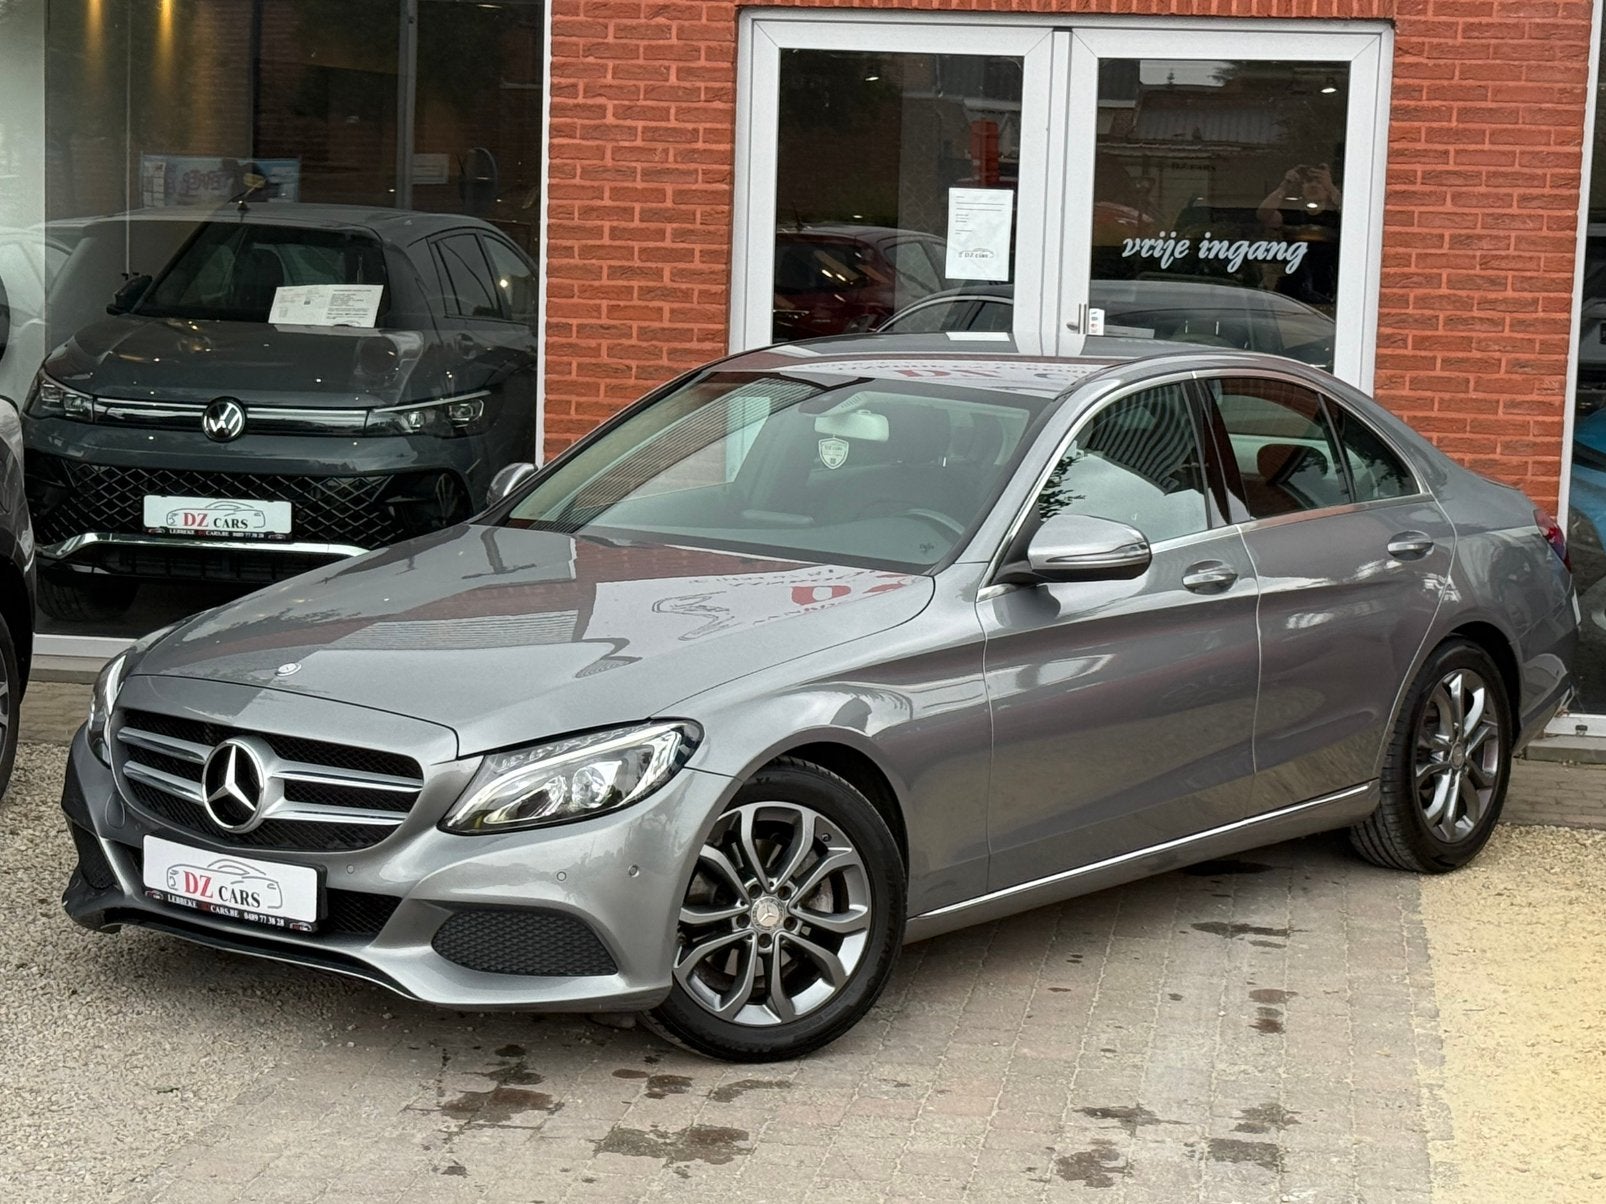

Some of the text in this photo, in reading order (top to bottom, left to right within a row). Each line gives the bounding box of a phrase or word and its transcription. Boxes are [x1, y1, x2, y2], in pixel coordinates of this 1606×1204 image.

[1122, 231, 1308, 275] vrije ingang
[183, 512, 248, 529] DZ CARS
[183, 871, 261, 908] DZ CARS
[259, 915, 267, 924] 77
